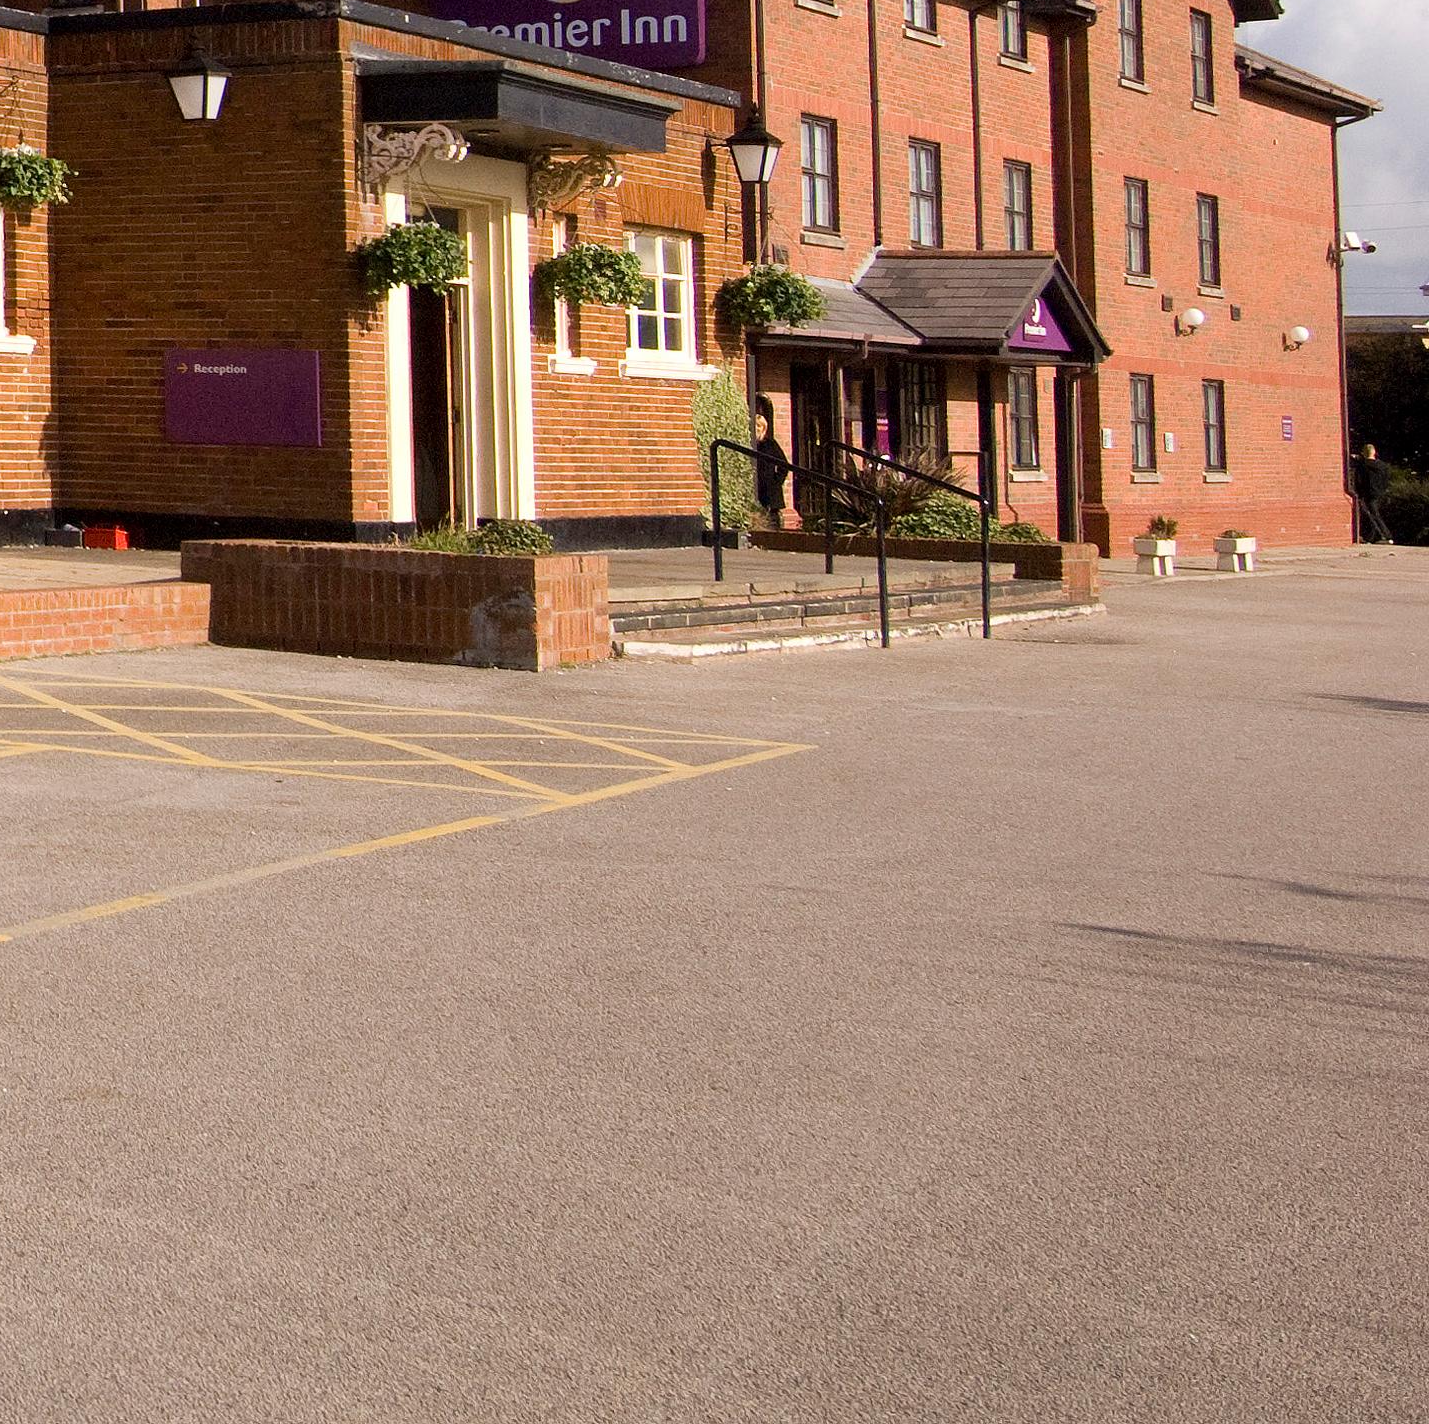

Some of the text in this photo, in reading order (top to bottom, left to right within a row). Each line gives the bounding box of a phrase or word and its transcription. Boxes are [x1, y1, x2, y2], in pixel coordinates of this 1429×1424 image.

[445, 9, 687, 49] mier Inn
[193, 363, 247, 376] Reception
